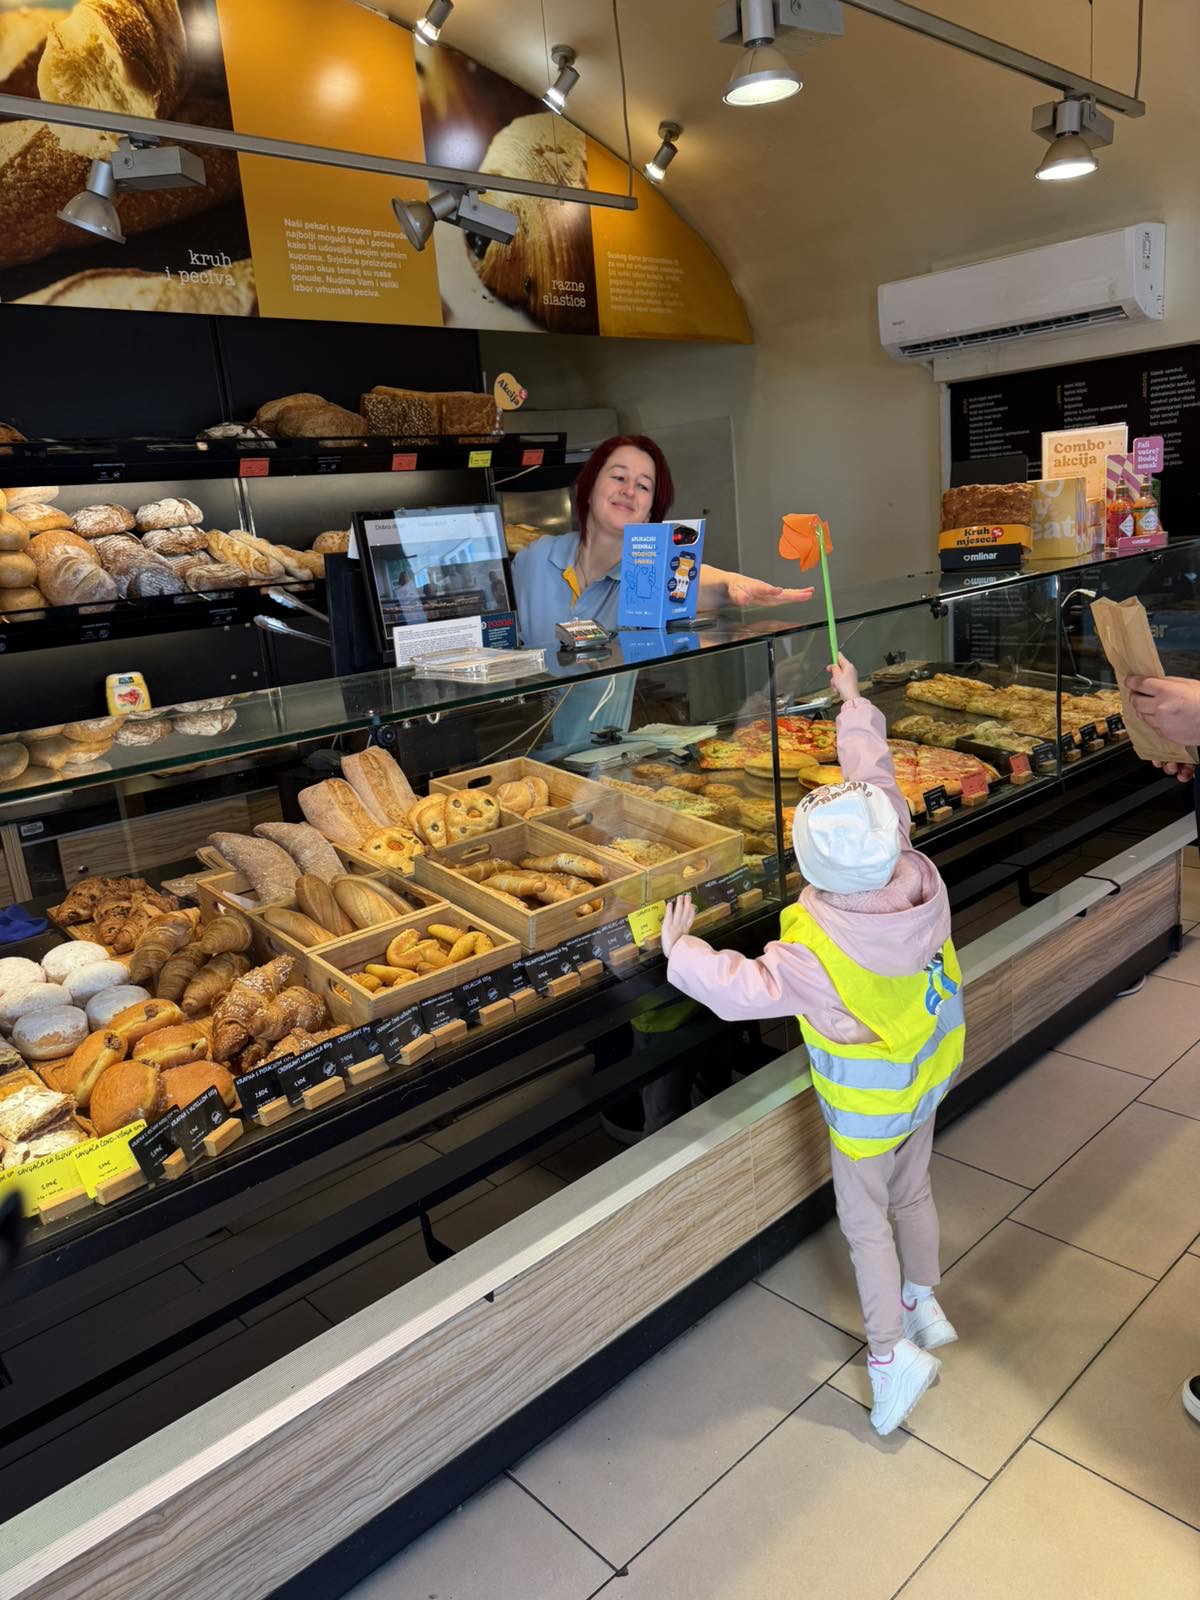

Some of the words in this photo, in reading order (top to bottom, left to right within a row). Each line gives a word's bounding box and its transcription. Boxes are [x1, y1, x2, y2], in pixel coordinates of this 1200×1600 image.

[305, 221, 328, 231] pekari
[338, 226, 372, 235] ponosom
[286, 231, 315, 241] najbolji
[348, 236, 365, 245] kruh
[371, 240, 395, 249] peciva
[287, 240, 306, 249] kako
[189, 249, 233, 268] kruh
[164, 267, 171, 281] i
[179, 270, 236, 288] peciva
[326, 275, 356, 285] Nudimo
[552, 279, 585, 292] razne
[543, 293, 586, 307] slastice
[498, 379, 520, 406] Akcija
[1054, 439, 1106, 454] Combo
[1054, 453, 1097, 468] akcija
[1137, 454, 1159, 463] Dodaj
[964, 527, 990, 536] Kruh
[956, 535, 998, 546] mjeseca
[970, 552, 998, 561] mlinar
[336, 1030, 362, 1044] CROISSANT
[276, 1059, 301, 1074] CROISSANT
[300, 1048, 323, 1062] MARELICA
[235, 1072, 255, 1085] KRAFNA
[170, 1111, 187, 1126] KRAFNA
[16, 1161, 45, 1176] SAVIJAČA
[45, 1156, 54, 1165] SA
